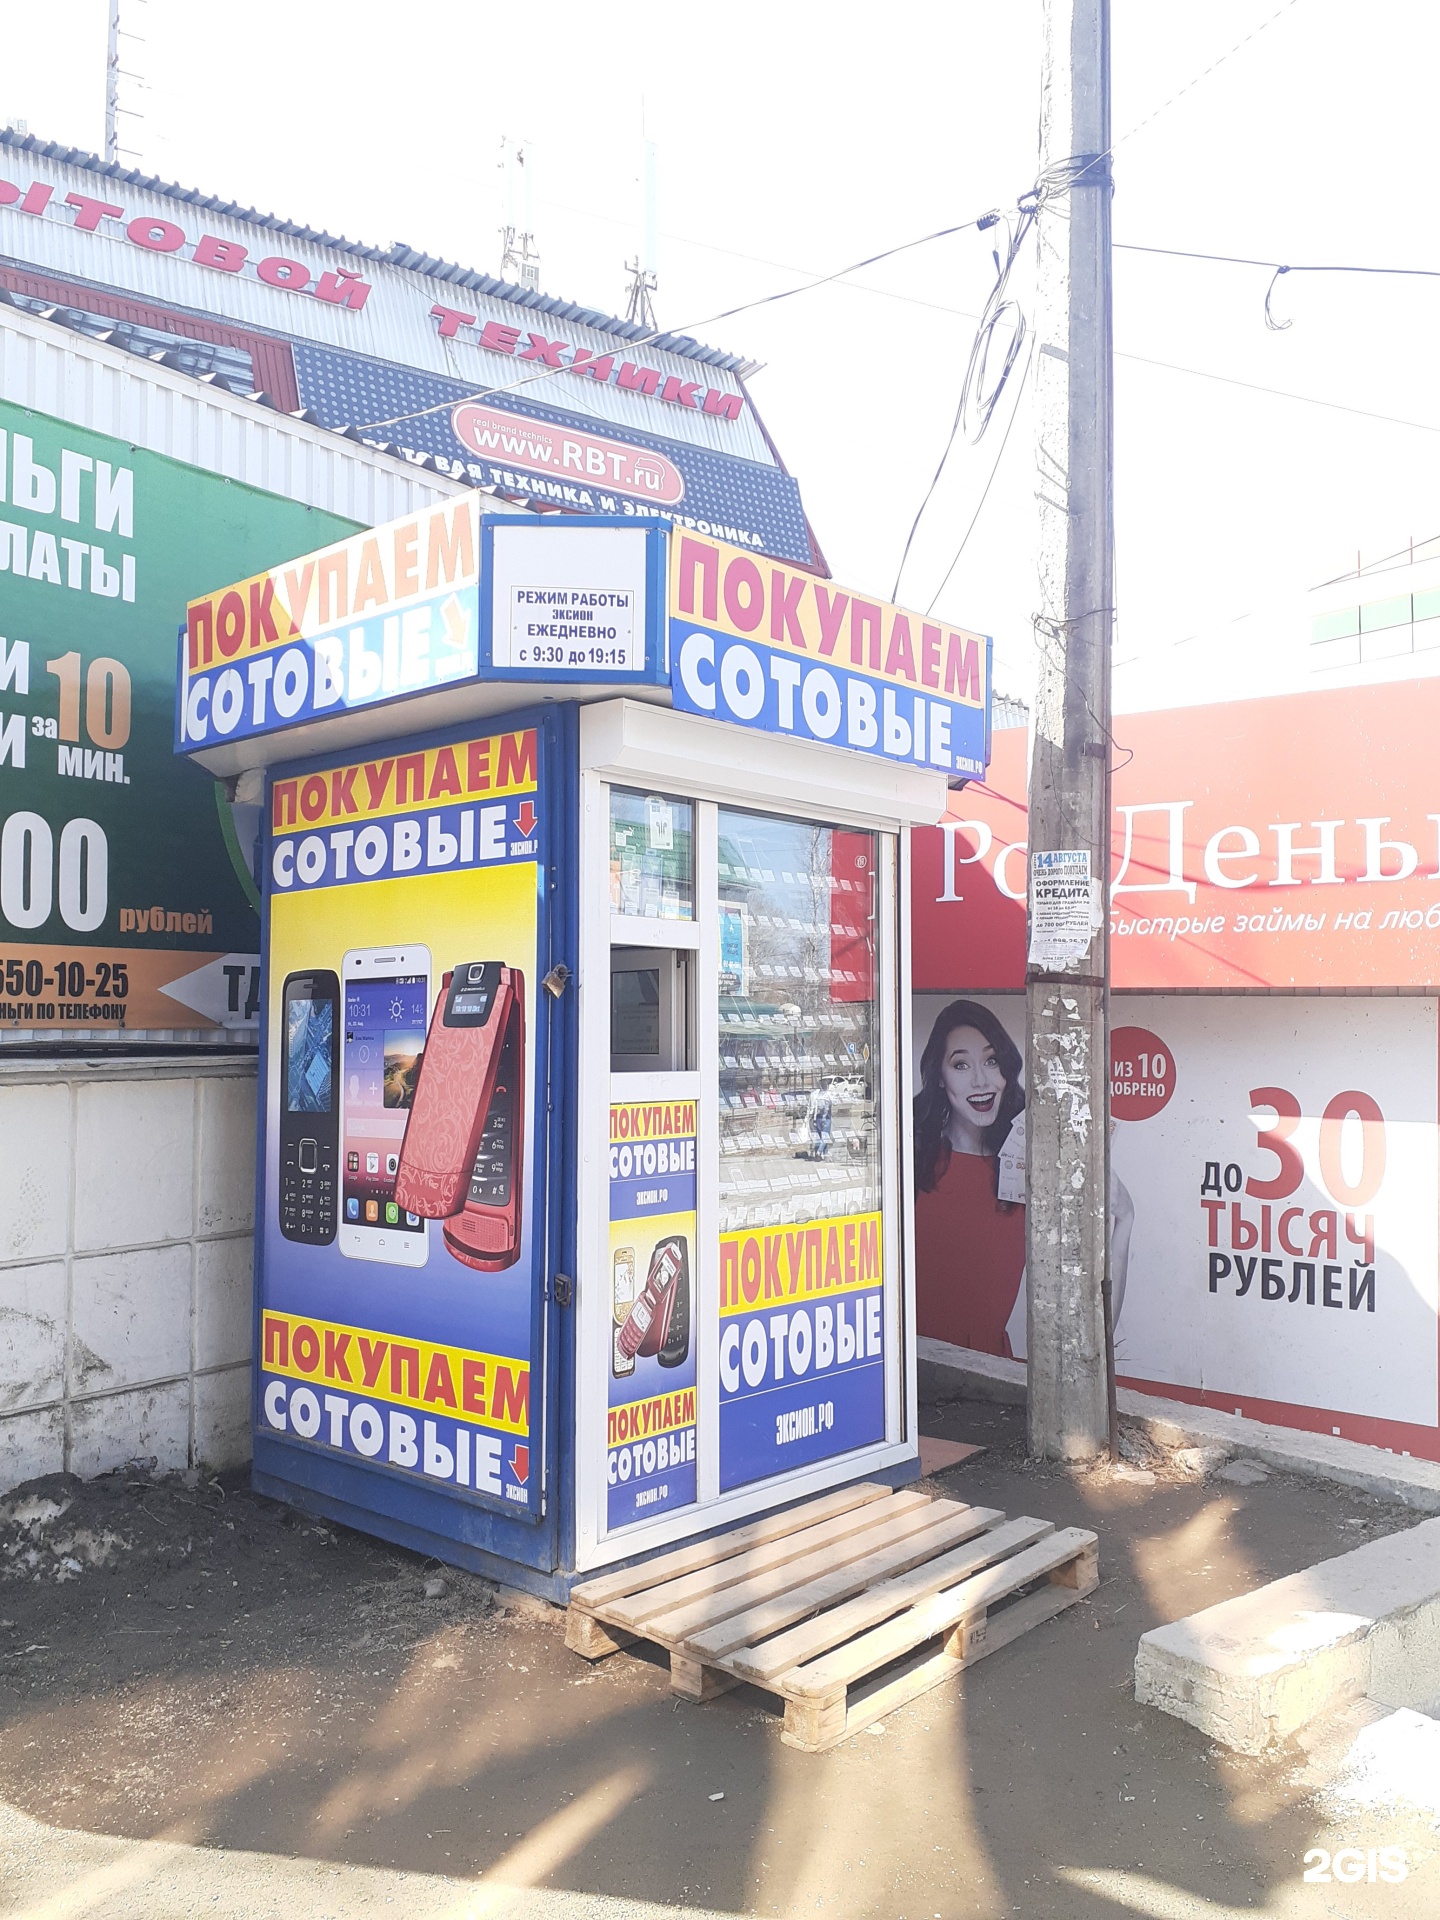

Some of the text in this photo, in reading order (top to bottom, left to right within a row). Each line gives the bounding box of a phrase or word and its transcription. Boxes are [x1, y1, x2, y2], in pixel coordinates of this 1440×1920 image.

[431, 304, 744, 420] ТЕХНИКИ
[473, 417, 553, 445] real brand technics
[472, 426, 661, 492] www.RBT.ru
[490, 468, 594, 507] ТЕХНИКА
[601, 496, 616, 512] И
[187, 501, 475, 669] ПОКУПАЕМ
[517, 590, 629, 608] РЕЖИМ РАБОТЫ
[527, 623, 617, 639] ЕЖЕДНЕВНО
[552, 608, 594, 621] ЭКСИОН
[679, 535, 981, 702] ПОКУПАЕМ
[186, 605, 432, 742] СОТОВЫЕ
[533, 645, 563, 663] 9:30
[568, 650, 585, 665] до
[588, 647, 626, 664] 19:15
[31, 715, 58, 740] за
[46, 650, 132, 749] 10
[679, 632, 952, 768] СОТОВЫЕ
[273, 729, 538, 828] ПОКУПАЕМ
[272, 804, 507, 888] СОТОВЫЕ
[1037, 852, 1053, 869] 14
[1053, 852, 1088, 863] АВГУСТА
[1035, 879, 1090, 887] ОФОРМЛЕНИЕ
[1035, 888, 1090, 899] КРЕДИТА
[119, 906, 213, 936] рублей
[1233, 906, 1326, 934] займы
[1334, 909, 1373, 931] на
[37, 1003, 54, 1019] ПО
[58, 1003, 126, 1019] ТЕЛЕФОНУ
[349, 1004, 371, 1017] 10:31
[1114, 1053, 1166, 1079] ИЗ 10
[610, 1104, 695, 1139] ПОКУПАЕМ
[609, 1140, 695, 1179] СОТОВЫЕ
[1246, 1086, 1387, 1208] 30
[1200, 1199, 1375, 1264] ТЫСЯЧ
[720, 1219, 880, 1308] ПОКУПАЕМ
[1208, 1252, 1376, 1313] РУБЛЕЙ
[720, 1294, 882, 1393] СОТОВЫЕ
[265, 1316, 530, 1427] ПОКУПАЕМ
[264, 1380, 502, 1496] СОТОВЫЕ
[608, 1391, 695, 1445] ПОКУПАЕМ
[776, 1400, 834, 1446] ЭКСИОН.РФ
[607, 1429, 695, 1485] СОТОВЫЕ
[505, 1483, 528, 1504] ЭКСИОН
[635, 1484, 668, 1508] ЭКСИОН.РФ
